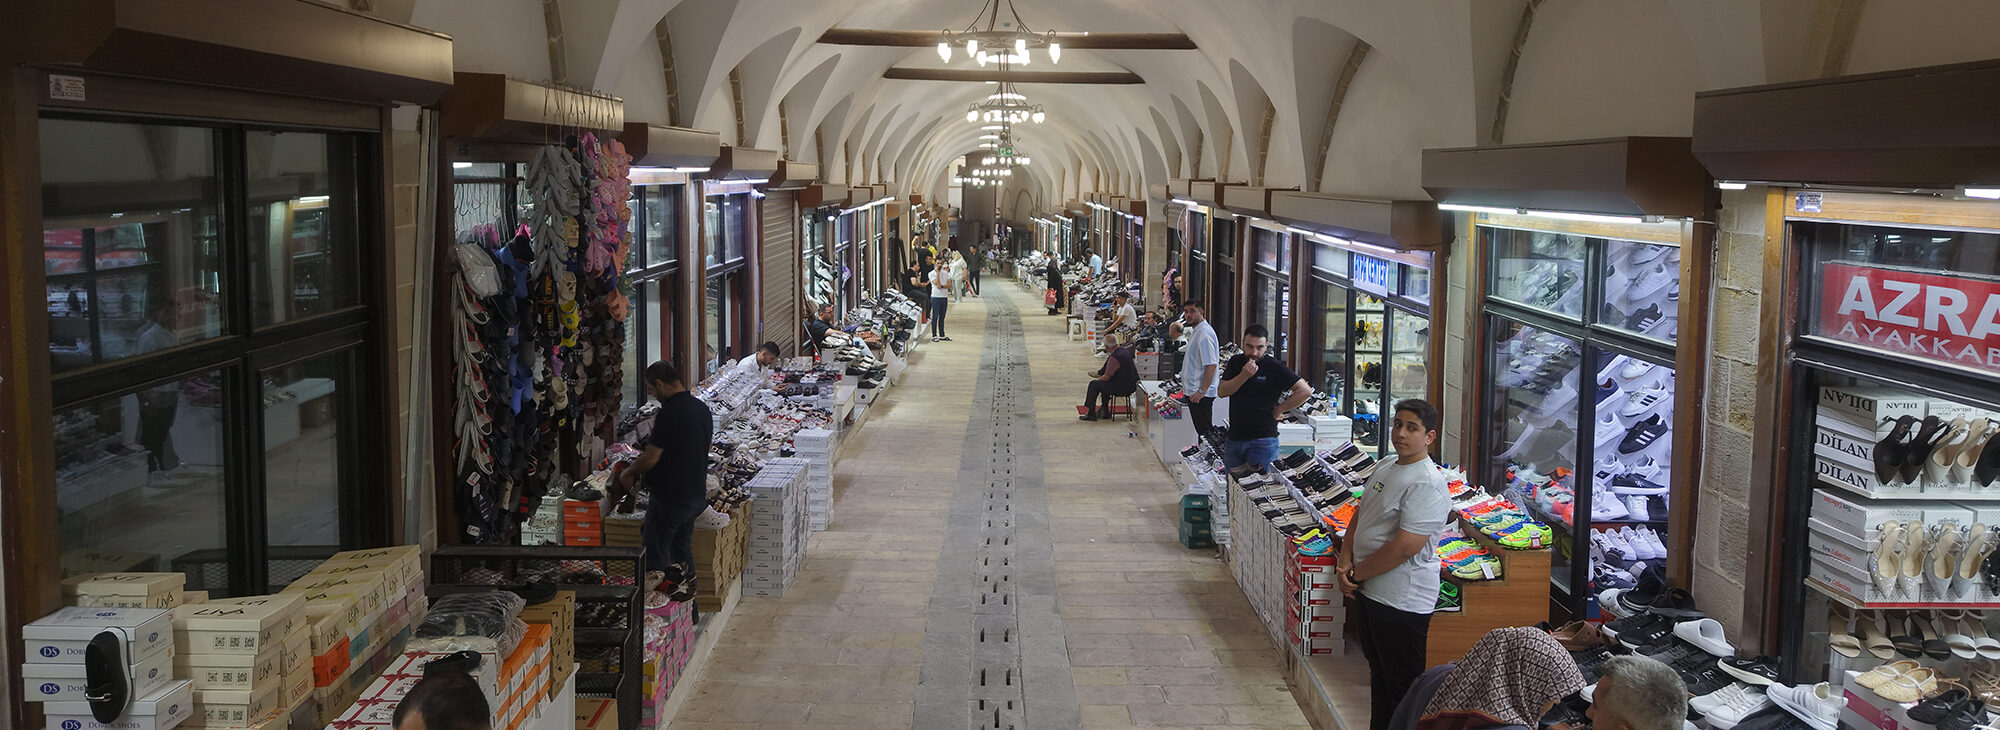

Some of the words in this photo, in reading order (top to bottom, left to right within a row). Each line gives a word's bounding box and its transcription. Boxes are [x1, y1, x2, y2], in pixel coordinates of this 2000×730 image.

[1838, 275, 2000, 340] AZRA
[1819, 432, 1869, 460] DİLAN
[1818, 461, 1869, 490] DİLAN
[42, 647, 59, 656] DS
[42, 683, 59, 693] DS
[63, 720, 80, 730] DS
